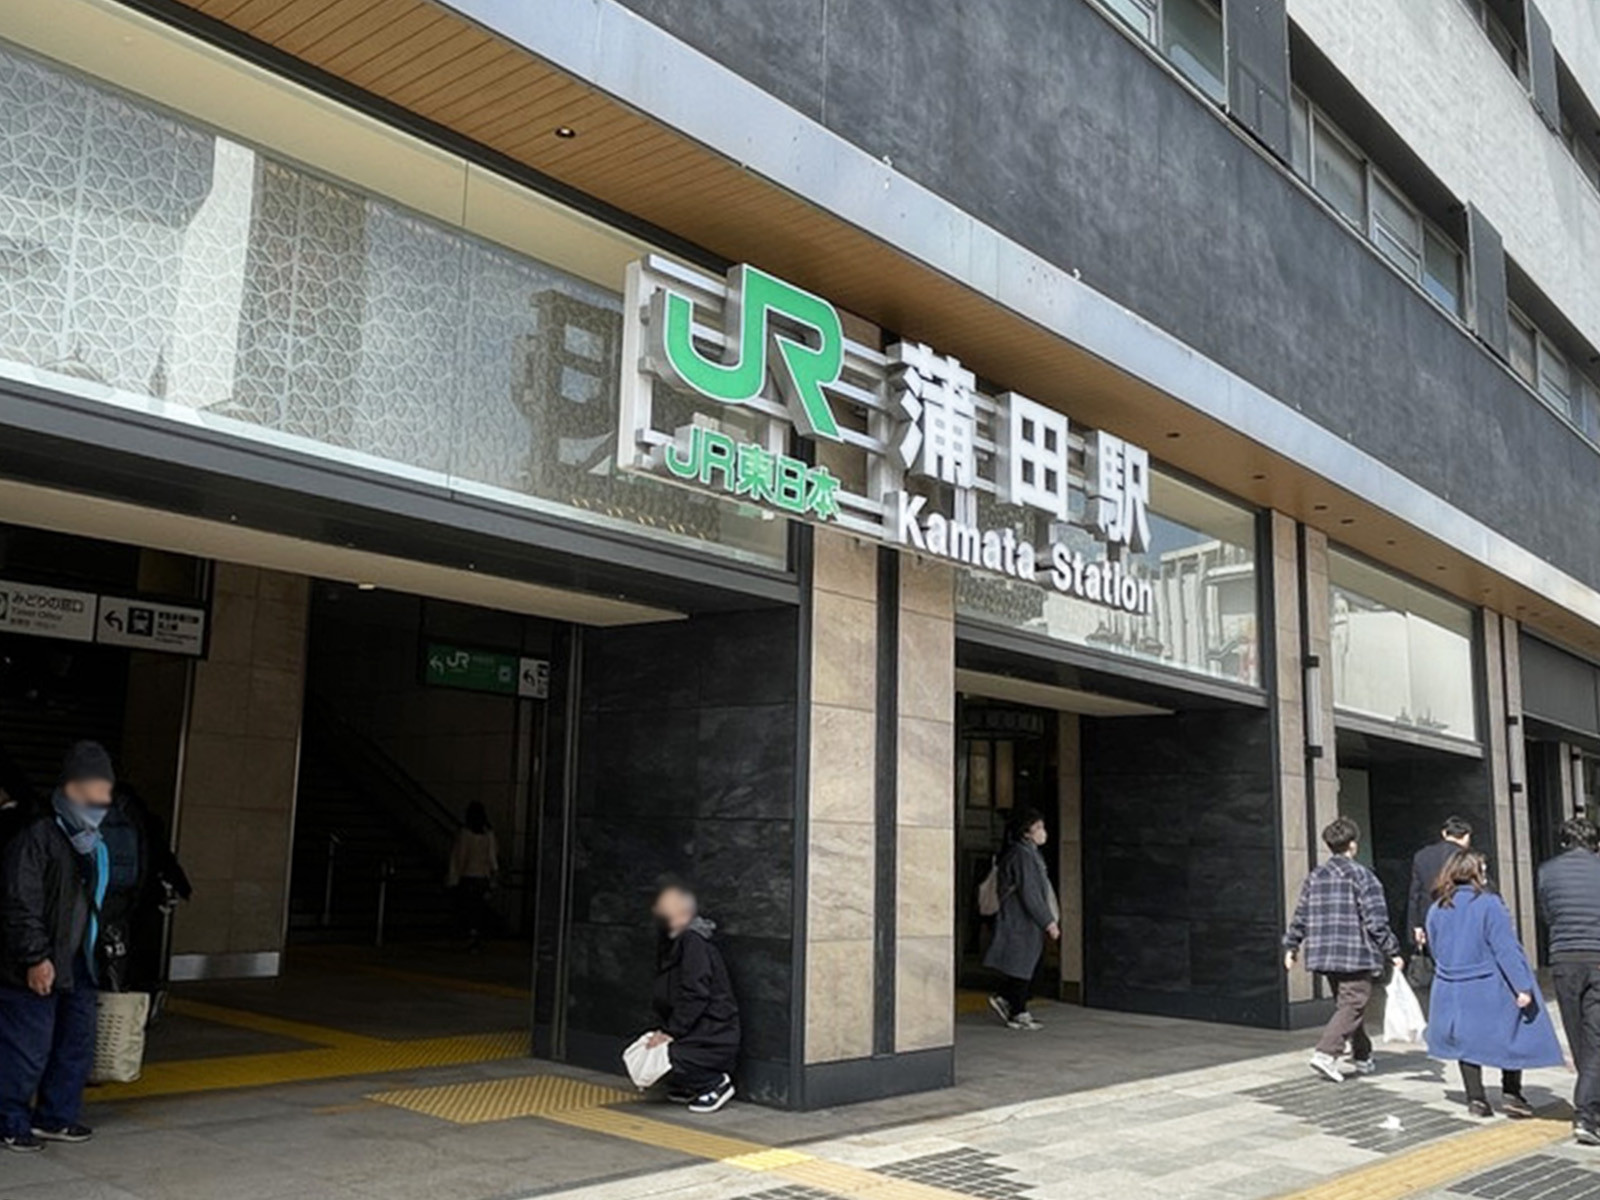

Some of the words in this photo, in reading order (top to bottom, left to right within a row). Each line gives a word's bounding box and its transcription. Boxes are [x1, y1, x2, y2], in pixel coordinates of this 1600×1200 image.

[664, 263, 844, 443] JR
[665, 423, 841, 520] JR東日本
[899, 343, 1151, 552] 蒲田駅
[898, 490, 1035, 581] Kamata
[1051, 543, 1153, 614] Station
[446, 651, 470, 669] JR
